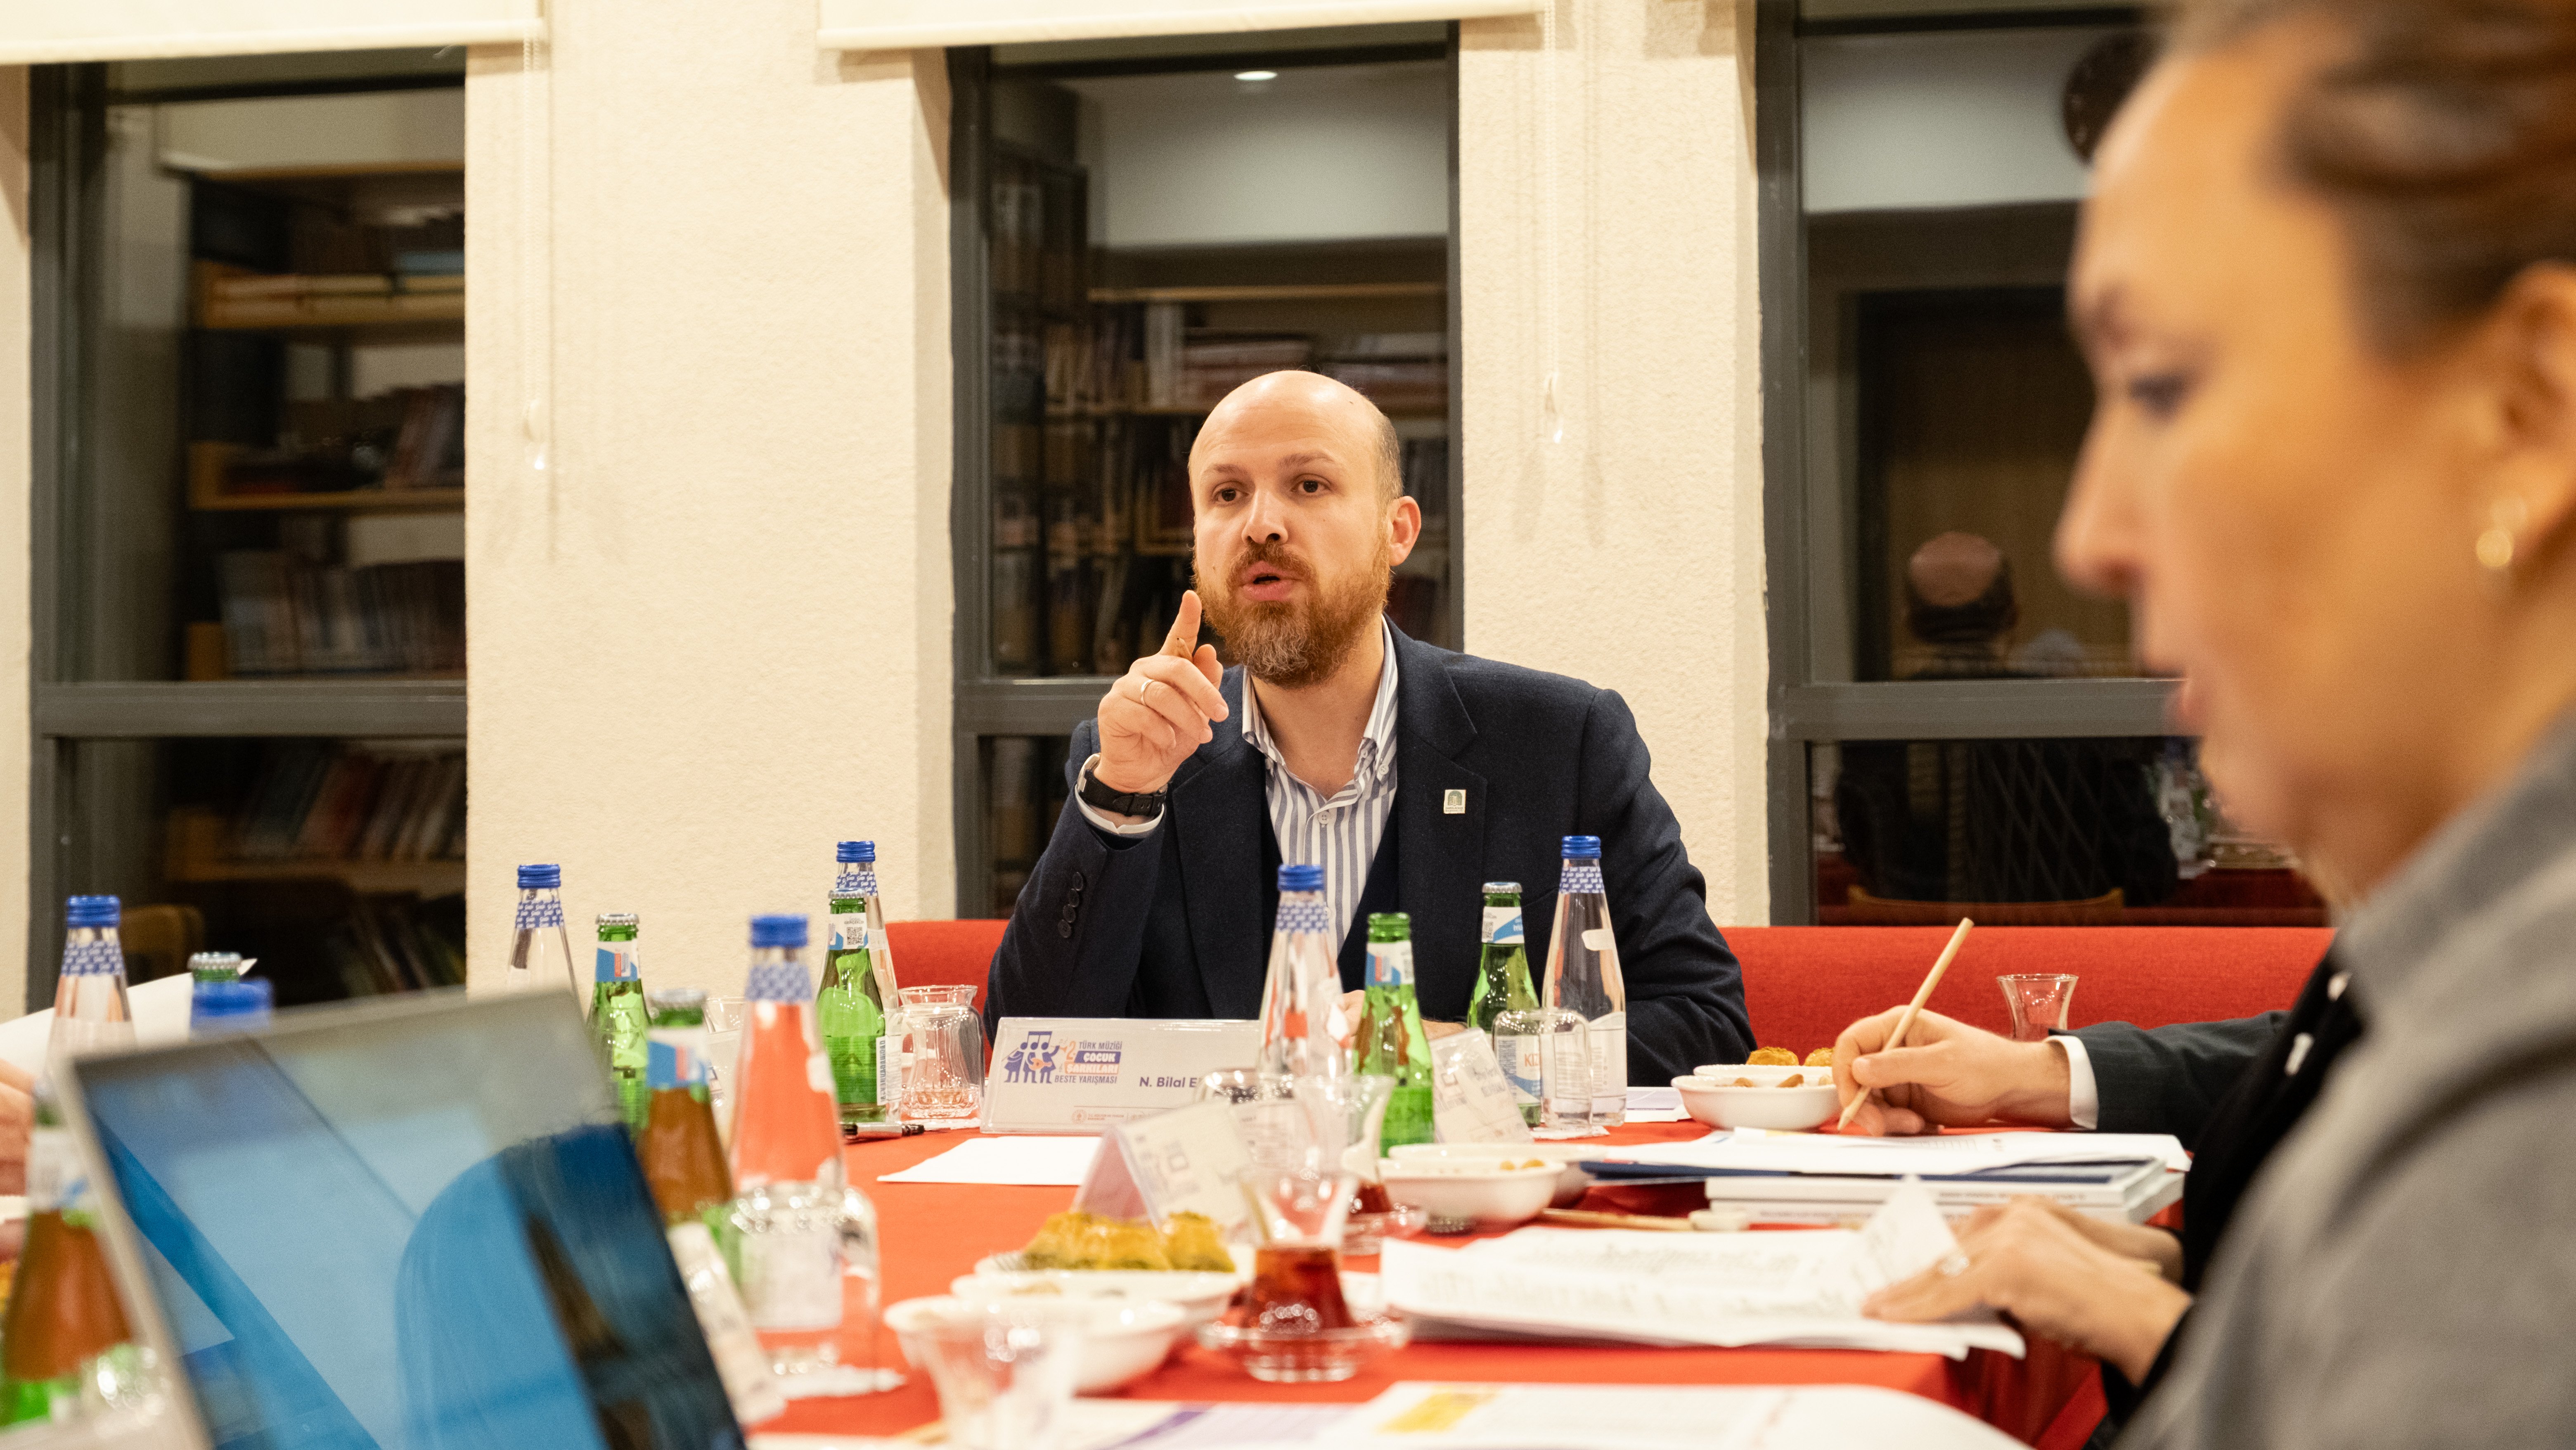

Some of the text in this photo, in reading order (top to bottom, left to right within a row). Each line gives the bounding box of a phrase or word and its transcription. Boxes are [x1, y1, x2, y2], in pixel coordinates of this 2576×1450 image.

[1079, 1040, 1122, 1050] TÜRK MÜZİĞİ
[1083, 1053, 1115, 1062] ÇOCUK
[1067, 1064, 1119, 1073] ŞARKILARI
[1079, 1076, 1117, 1085] YARIŞMASI
[1139, 1077, 1152, 1087] N.
[1157, 1076, 1185, 1088] Bilal
